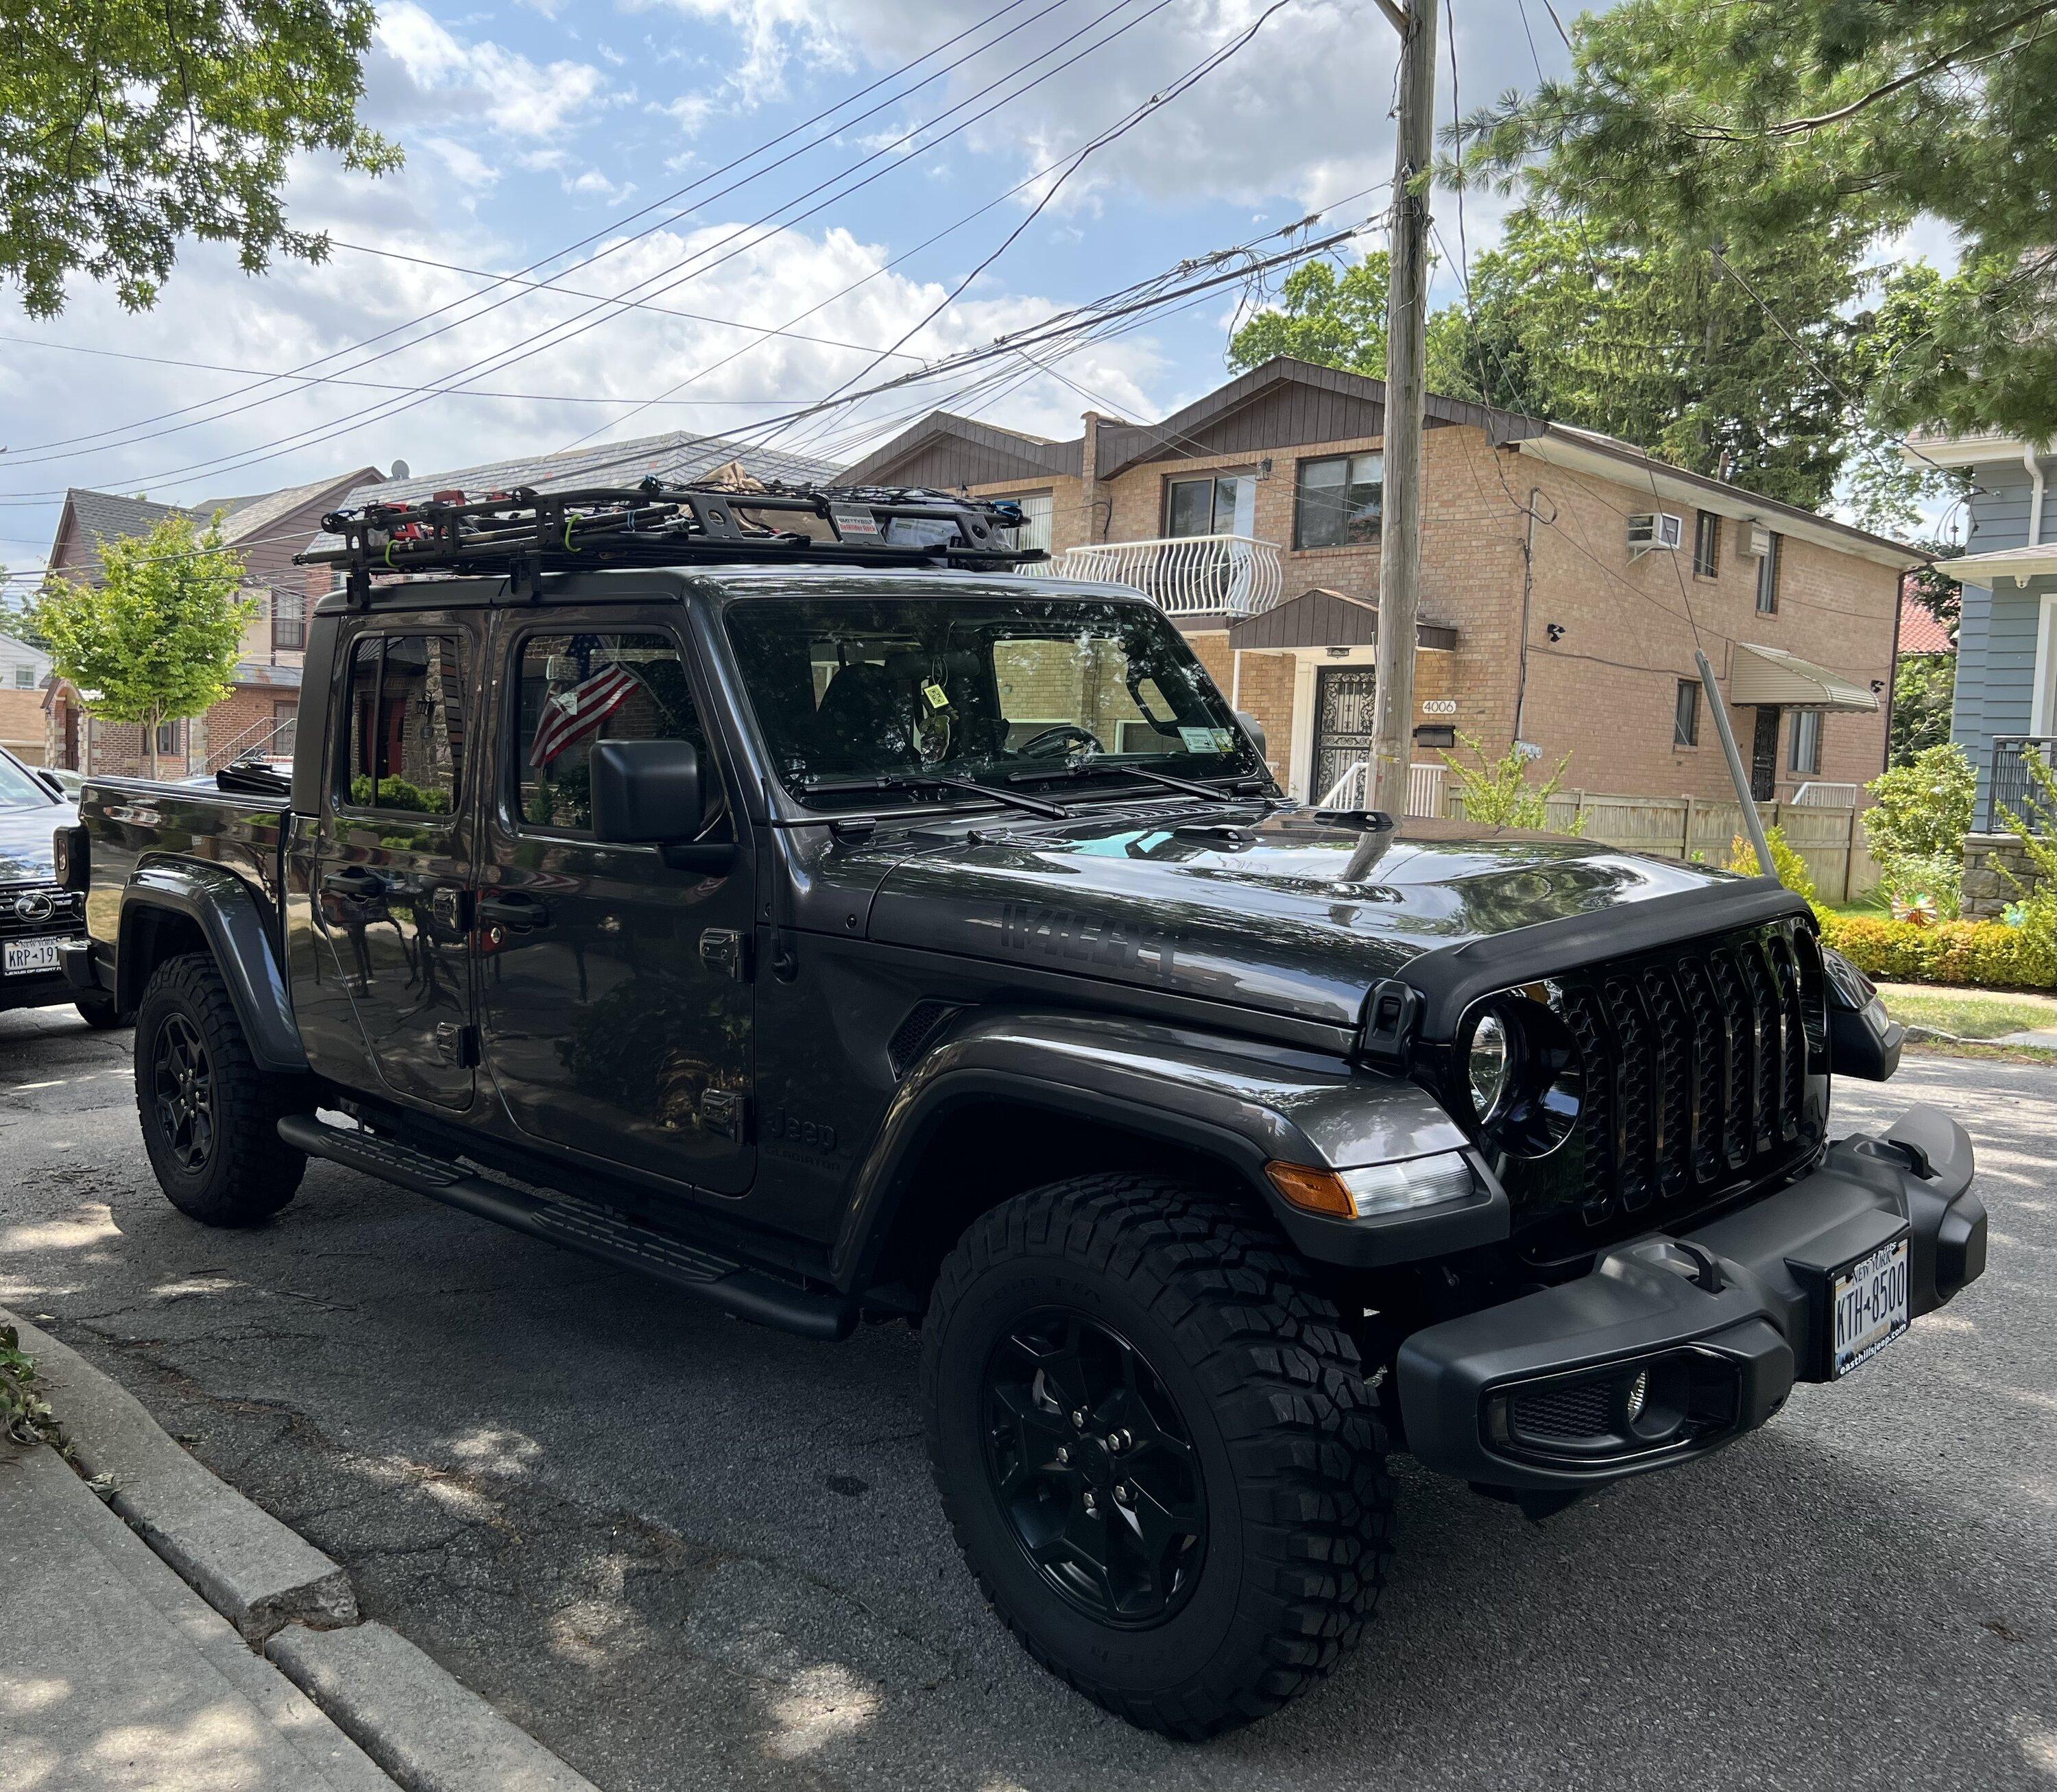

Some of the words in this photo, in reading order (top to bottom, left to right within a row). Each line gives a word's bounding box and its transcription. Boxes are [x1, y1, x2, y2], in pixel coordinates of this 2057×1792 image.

[1424, 701, 1454, 712] 4006
[21, 941, 36, 949] NEW
[766, 1106, 838, 1156] Jeep
[1851, 1263, 1870, 1286] NEW
[1870, 1250, 1891, 1273] YORK
[1840, 1323, 1906, 1375] easthillsjeep.com
